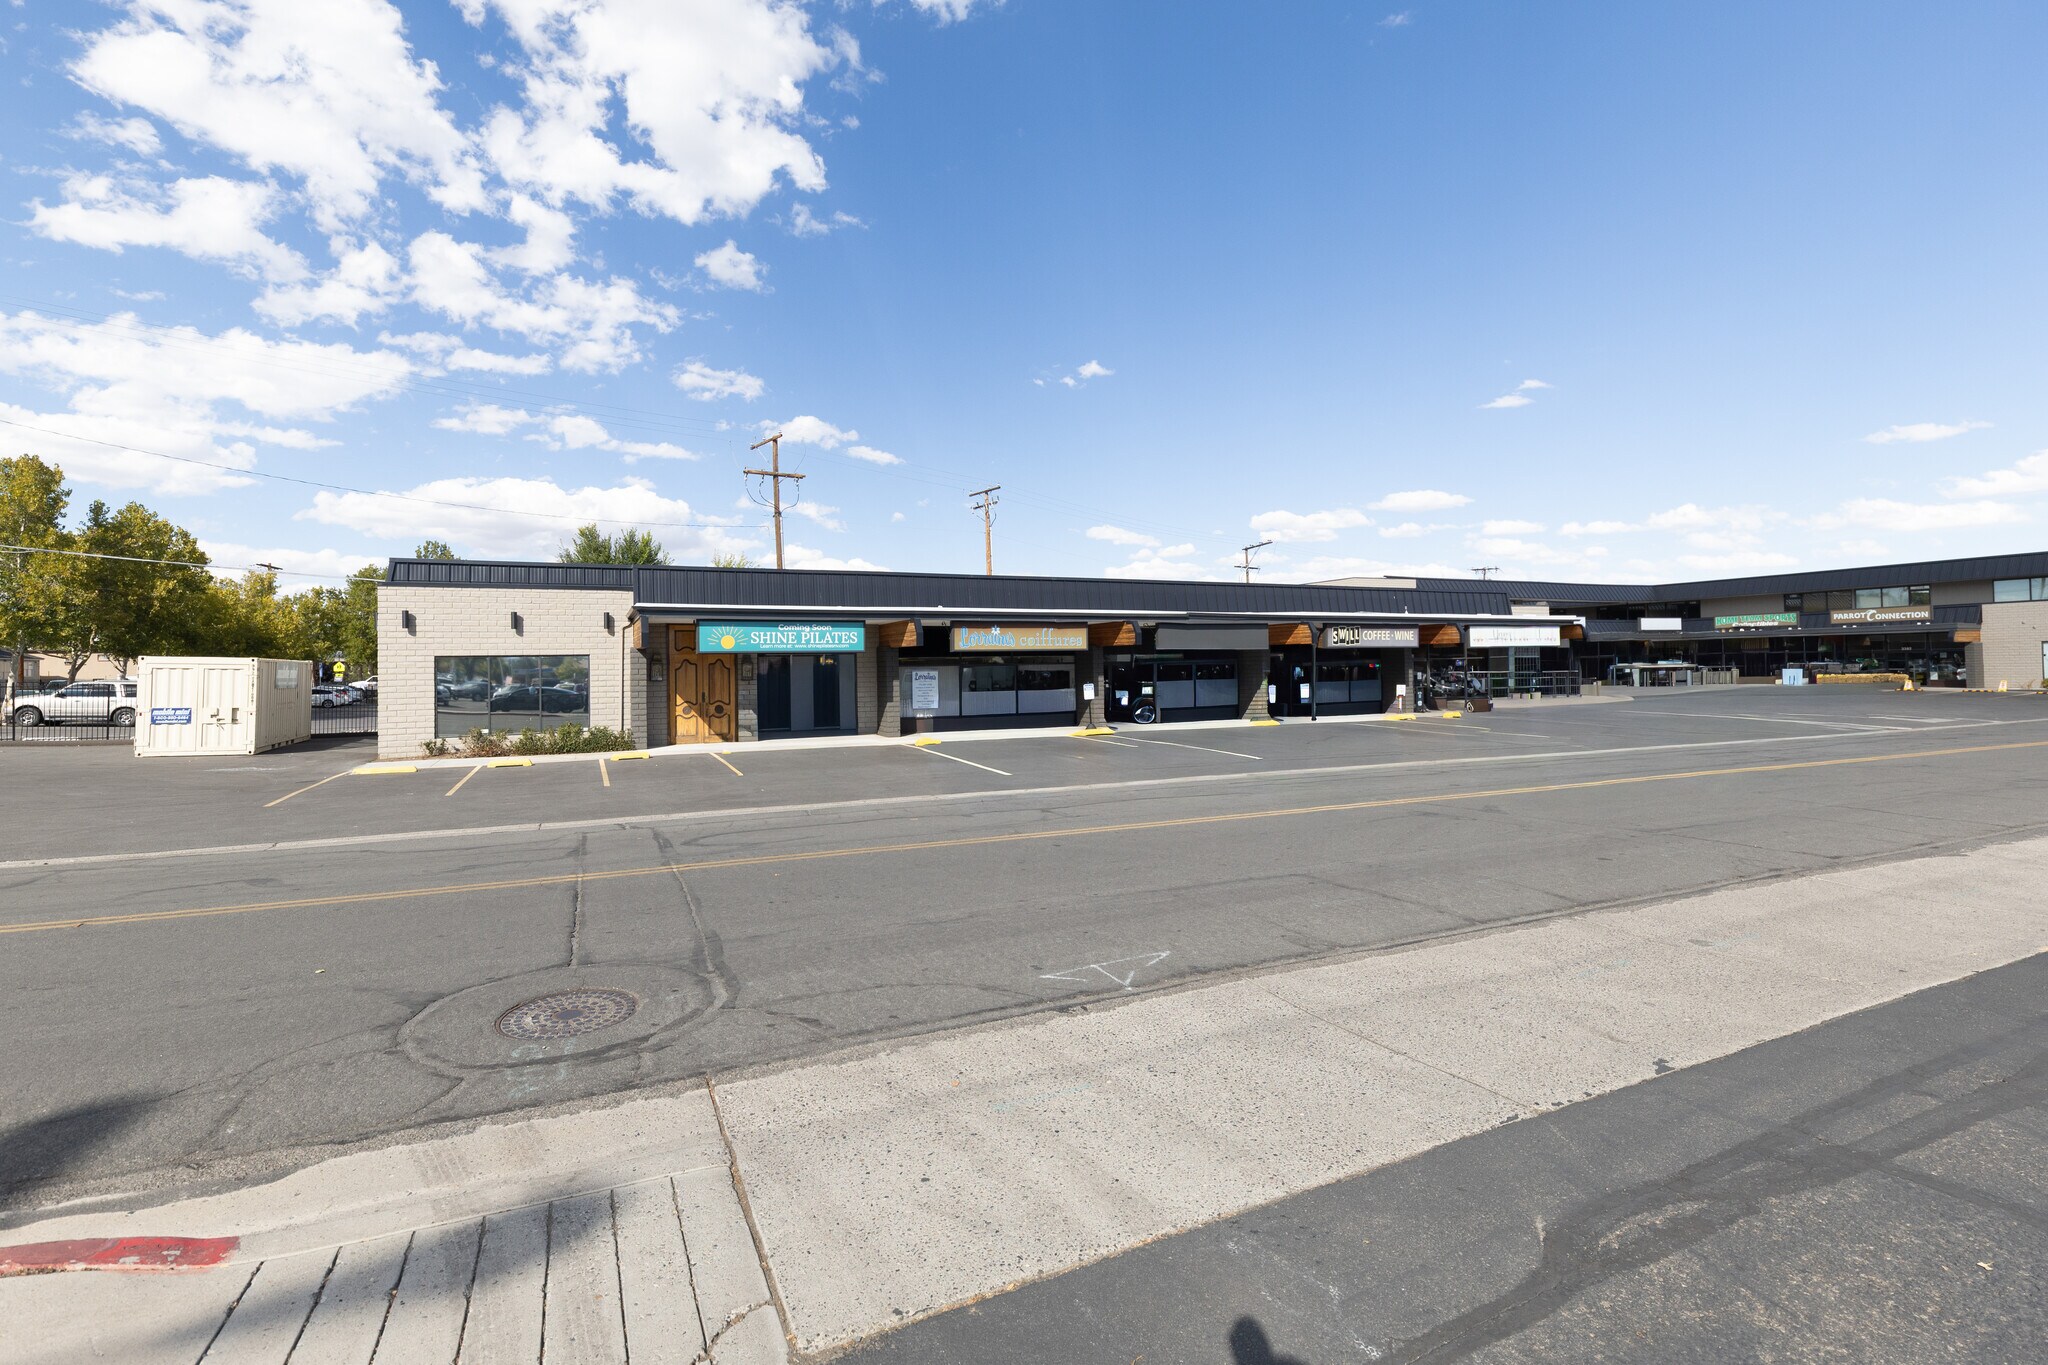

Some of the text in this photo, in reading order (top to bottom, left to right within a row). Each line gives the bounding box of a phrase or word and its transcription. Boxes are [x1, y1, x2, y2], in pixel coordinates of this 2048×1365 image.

[1715, 616, 1739, 626] HOME
[1764, 613, 1797, 623] SPORTS
[1833, 609, 1928, 621] PARROT CONNECTION
[778, 624, 810, 632] Coming
[750, 631, 858, 644] SHINE PILATES
[1019, 627, 1083, 647] coiffures
[1332, 627, 1414, 644] SWILL COFFEE WINE
